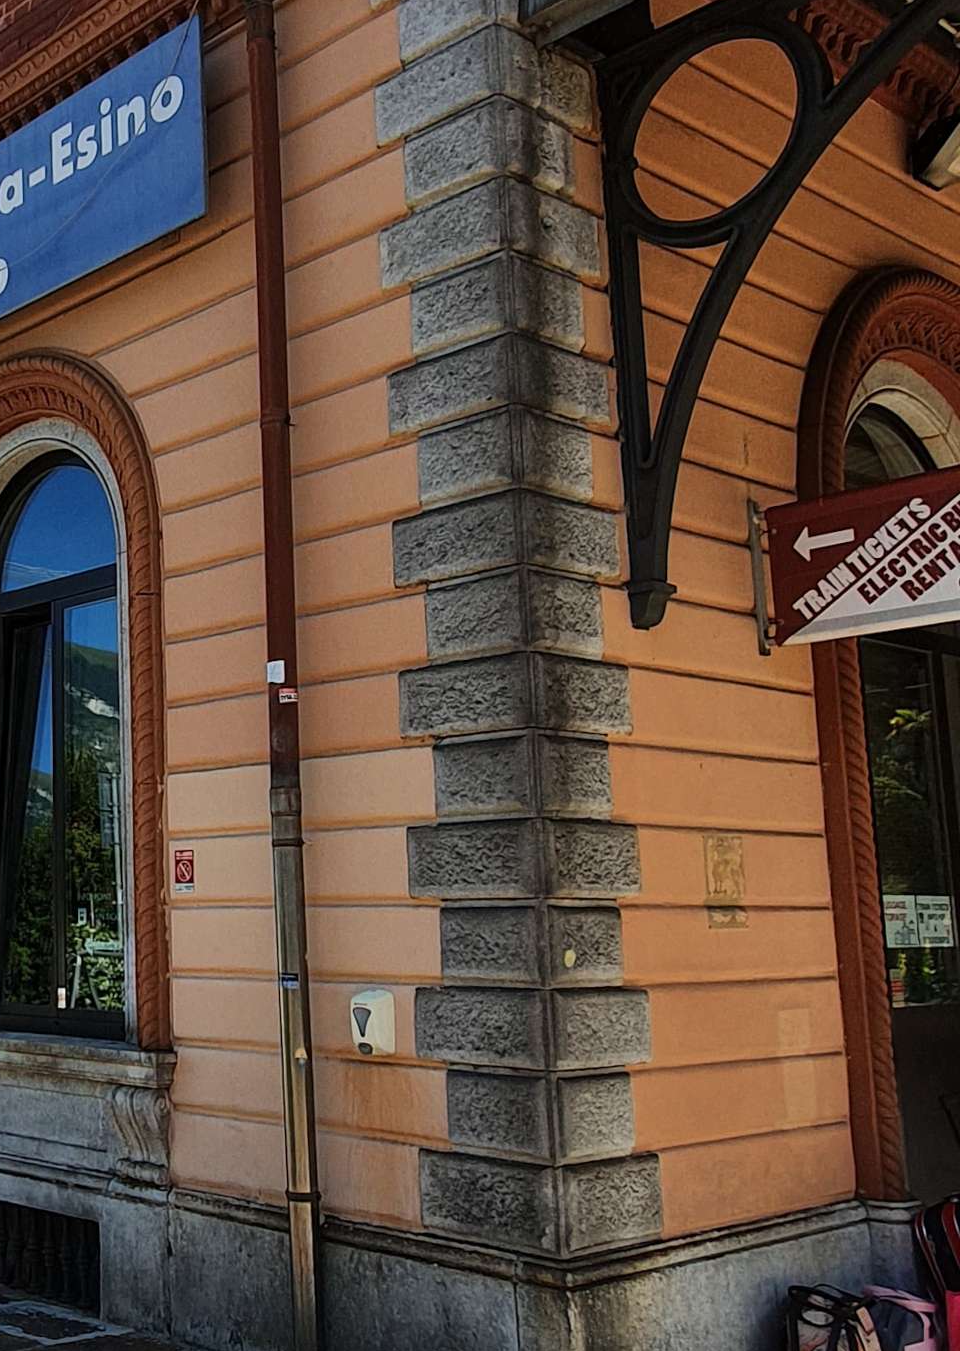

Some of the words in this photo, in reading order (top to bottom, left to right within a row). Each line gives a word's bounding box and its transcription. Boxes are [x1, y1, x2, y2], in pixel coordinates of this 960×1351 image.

[792, 562, 857, 621] TRAIN
[844, 497, 932, 575] TICKETS
[856, 522, 949, 605] ELECTRIC
